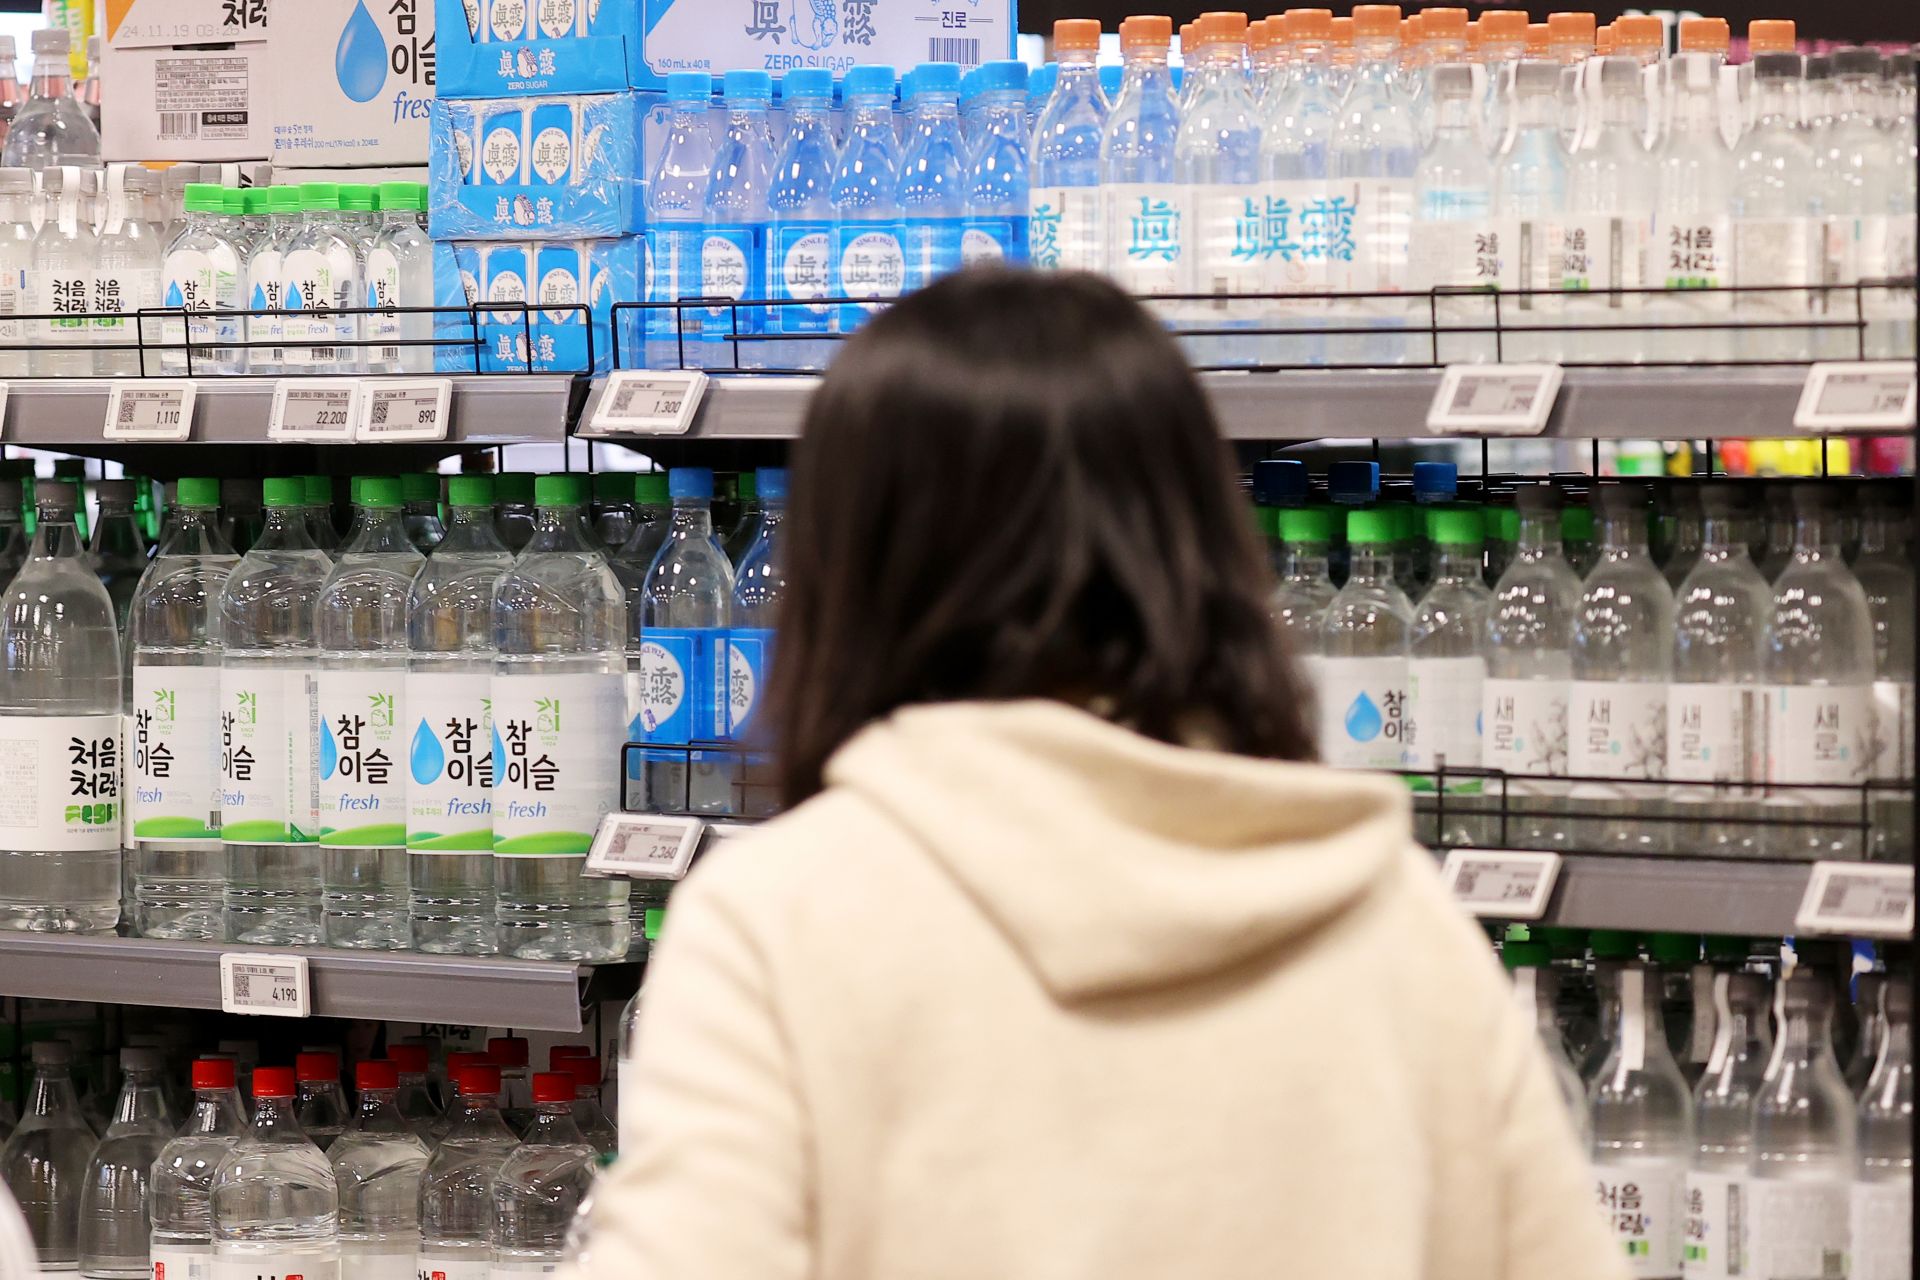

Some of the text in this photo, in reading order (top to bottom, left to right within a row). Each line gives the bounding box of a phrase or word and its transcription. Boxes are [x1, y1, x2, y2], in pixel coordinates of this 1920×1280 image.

[942, 11, 967, 28] 진로
[497, 47, 557, 78] 眞 露
[765, 54, 802, 70] ZERO
[507, 80, 548, 90] ZERO SUGAR
[393, 91, 432, 124] fres
[494, 196, 554, 224] 眞 露
[1670, 225, 1714, 249] 처음
[1670, 251, 1716, 272] 처럼
[52, 279, 86, 297] 처음
[95, 278, 121, 297] 처음
[184, 279, 199, 300] 참
[266, 281, 281, 301] 참
[302, 280, 317, 300] 참
[377, 278, 387, 299] 참
[52, 298, 87, 313] 처럼
[94, 298, 122, 313] 처럼
[307, 322, 328, 336] fresh
[496, 333, 557, 363] 眞 露
[418, 410, 436, 423] 890
[1384, 689, 1406, 718] 참
[136, 708, 152, 744] 참
[221, 710, 235, 746] 참
[337, 713, 366, 750] 참
[445, 717, 478, 754] 참
[506, 719, 532, 756] 참
[69, 737, 117, 769] 처음
[136, 742, 175, 778] 이슬
[221, 745, 255, 781] 이슬
[339, 748, 393, 785] 이슬
[508, 754, 560, 791] 이슬
[70, 770, 118, 799] 처럼
[136, 786, 162, 803] fresh
[339, 791, 379, 812] fresh
[447, 797, 491, 817] fresh
[508, 800, 547, 820] fresh
